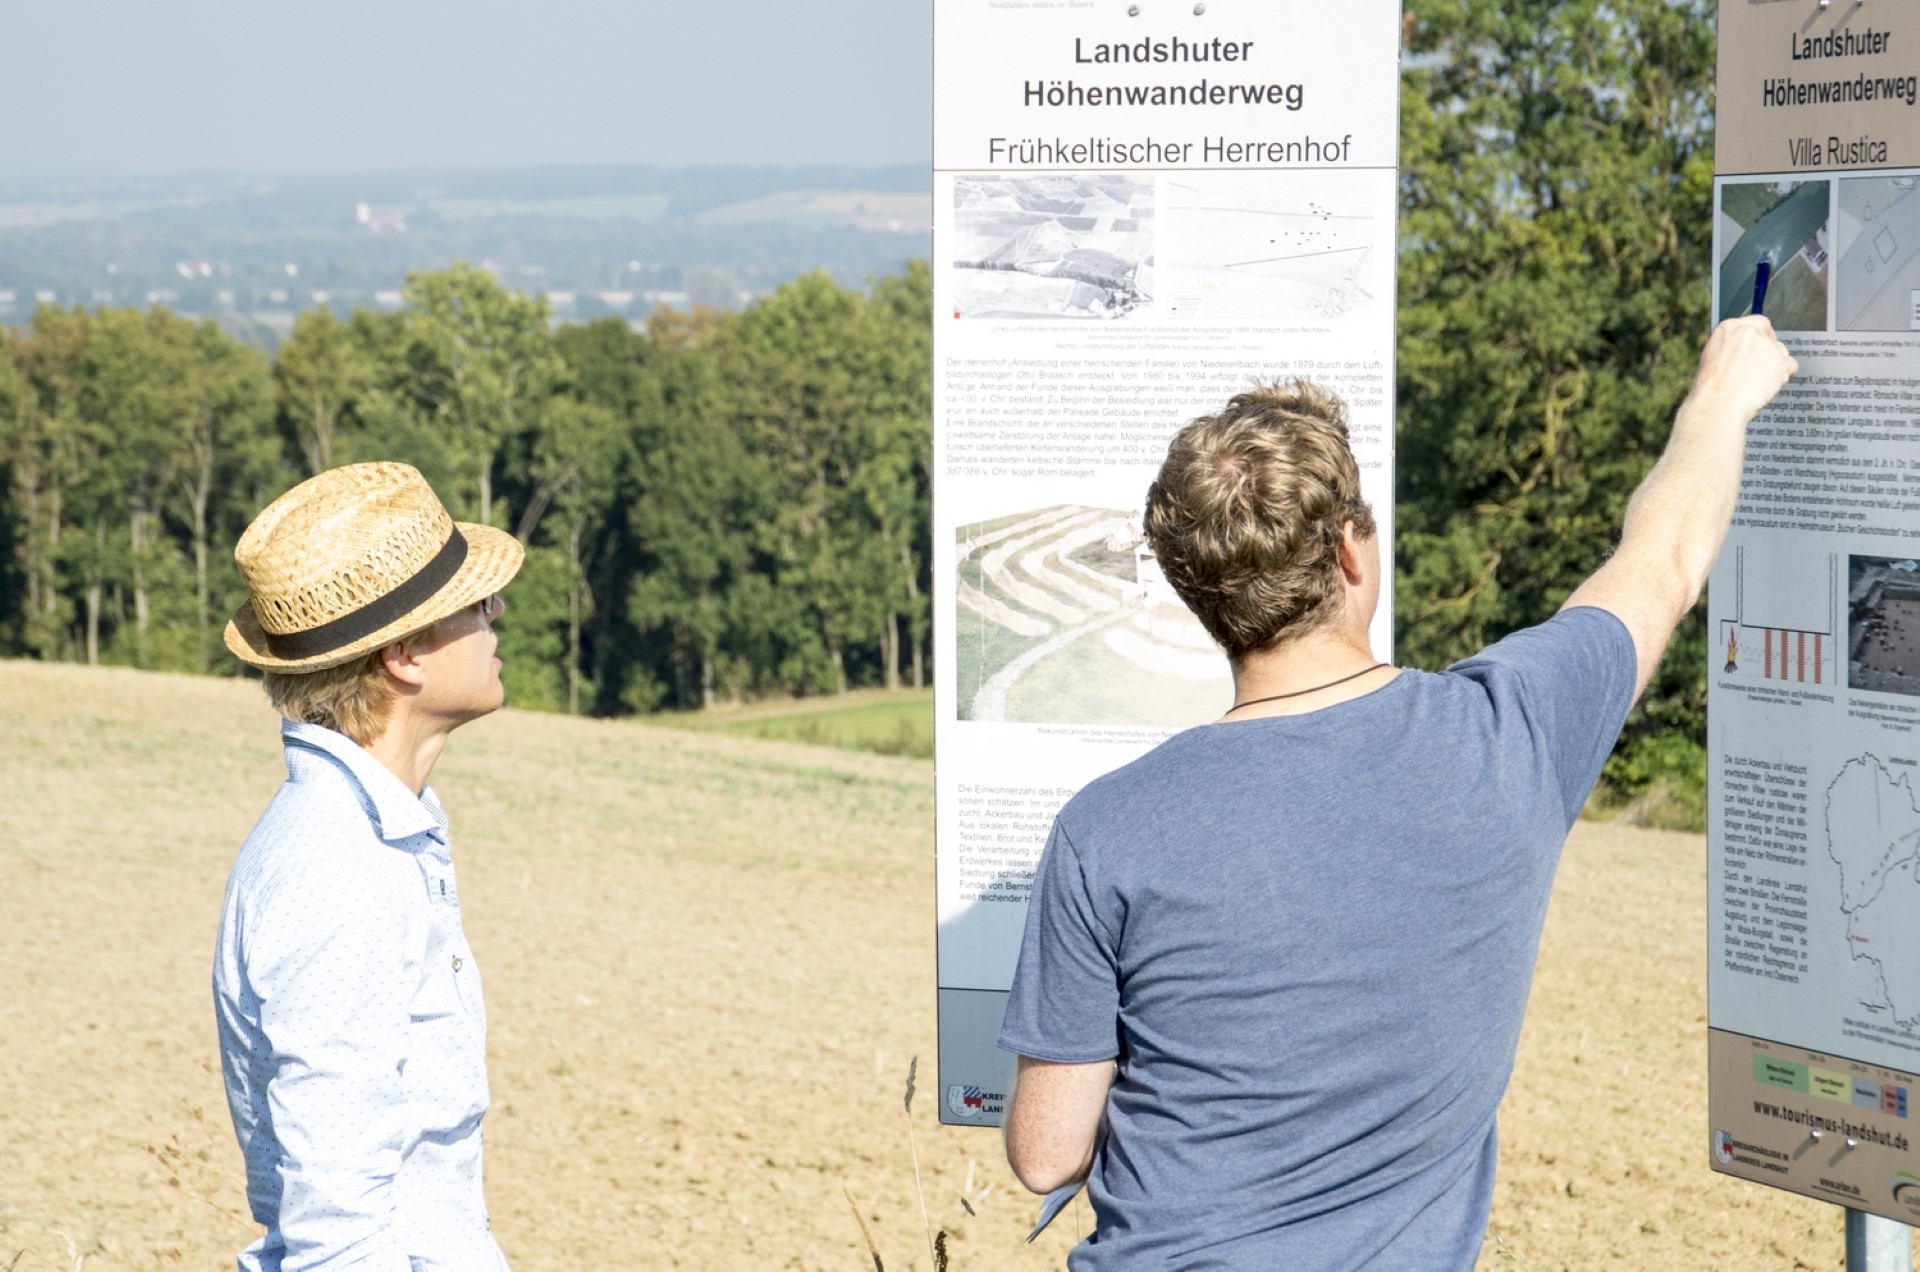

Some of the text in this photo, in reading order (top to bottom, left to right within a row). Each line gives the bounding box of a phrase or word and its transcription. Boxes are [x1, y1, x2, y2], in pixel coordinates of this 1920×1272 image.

[1075, 36, 1253, 63] Landshuter
[1792, 27, 1890, 61] Landshuter
[1024, 79, 1304, 110] Höhenwanderweg
[1763, 73, 1916, 107] Höhenwanderweg
[989, 135, 1352, 164] Frühkeltischer Herrenhof
[1789, 135, 1887, 166] Villa Rustica
[946, 357, 961, 367] Der
[1007, 358, 1058, 368] (Ansiedlung
[1060, 359, 1082, 368] einer
[1083, 359, 1143, 368] herrschenden
[1144, 358, 1180, 368] Familie)
[1181, 360, 1198, 368] von
[1199, 359, 1260, 368] Niedererlbach
[1262, 360, 1290, 369] wurde
[1293, 359, 1314, 369] 1979
[1316, 360, 1341, 369] durch
[1343, 361, 1360, 369] den
[1362, 360, 1382, 369] Luft-
[1016, 370, 1034, 380] Otto
[1038, 370, 1073, 380] Braasch
[1121, 371, 1137, 380] Von
[1143, 370, 1163, 380] 1980
[1167, 372, 1180, 380] bis
[1186, 371, 1206, 381] 1994
[1210, 371, 1238, 382] erfolgt
[1315, 373, 1330, 383] der
[1334, 373, 1382, 382] kompletten
[979, 382, 1013, 391] Anhand
[1014, 383, 1029, 392] der
[1030, 382, 1058, 392] Funde
[1060, 384, 1087, 392] dieser
[1088, 383, 1151, 394] Ausgrabungen
[1199, 385, 1221, 393] dass
[1369, 385, 1382, 395] bis
[1060, 394, 1090, 405] Beginn
[1091, 396, 1106, 405] der
[1156, 397, 1172, 405] war
[1174, 397, 1188, 405] nur
[1189, 396, 1204, 406] der
[1354, 398, 1382, 408] Später
[980, 406, 1000, 416] auch
[1046, 407, 1061, 416] der
[1062, 407, 1100, 417] Palisade
[1101, 407, 1142, 418] Gebäude
[1026, 419, 1040, 428] die
[1042, 420, 1053, 429] an
[1119, 420, 1149, 430] Stellen
[1150, 421, 1167, 430] des
[1044, 431, 1061, 441] der
[1061, 431, 1092, 442] Anlage
[1366, 435, 1382, 444] his-
[1030, 443, 1104, 454] Keltenwanderung
[1106, 445, 1120, 454] um
[979, 455, 1026, 464] wanderten
[1102, 457, 1118, 466] bis
[1118, 457, 1141, 466] nach
[1010, 468, 1035, 478] sogar
[1036, 467, 1057, 477] Rom
[957, 783, 1050, 796] Die Einwohnerzahl des
[958, 797, 983, 806] sonen
[1030, 799, 1040, 807] Im
[1043, 799, 1060, 808] und
[984, 809, 1025, 819] Ackerbau
[1025, 811, 1043, 819] und
[958, 820, 1050, 833] Aus lokalen Rohstoff
[996, 833, 1015, 842] Brot
[1016, 834, 1033, 843] und
[958, 843, 1029, 857] Die Verarbeitung
[958, 855, 1034, 868] Erdwerkes lassen
[959, 868, 995, 880] Siedlung
[959, 880, 1032, 891] Funde von Bernst
[960, 892, 1022, 902] weit reichender
[1753, 1100, 1909, 1152] www.tourismus-landshut.de
